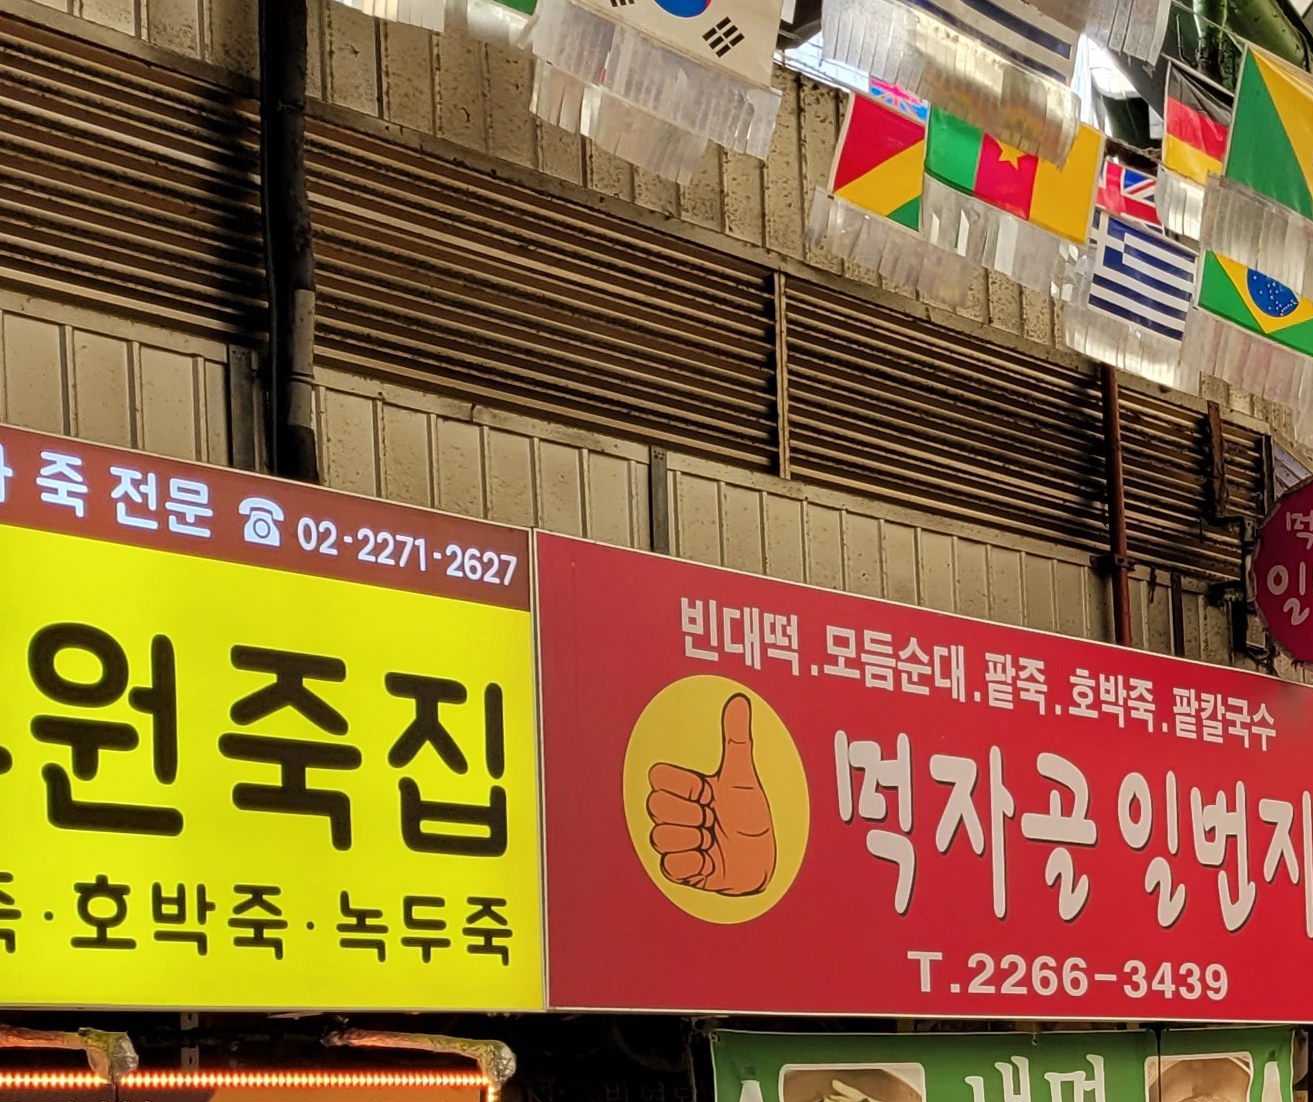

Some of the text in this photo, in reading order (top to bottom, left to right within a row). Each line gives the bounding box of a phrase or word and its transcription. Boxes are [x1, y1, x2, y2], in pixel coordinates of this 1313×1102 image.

[36, 450, 518, 588] 죽 전문 02-2271-2627
[0, 621, 509, 858] 원죽집
[907, 950, 1229, 1001] T.2266-3439
